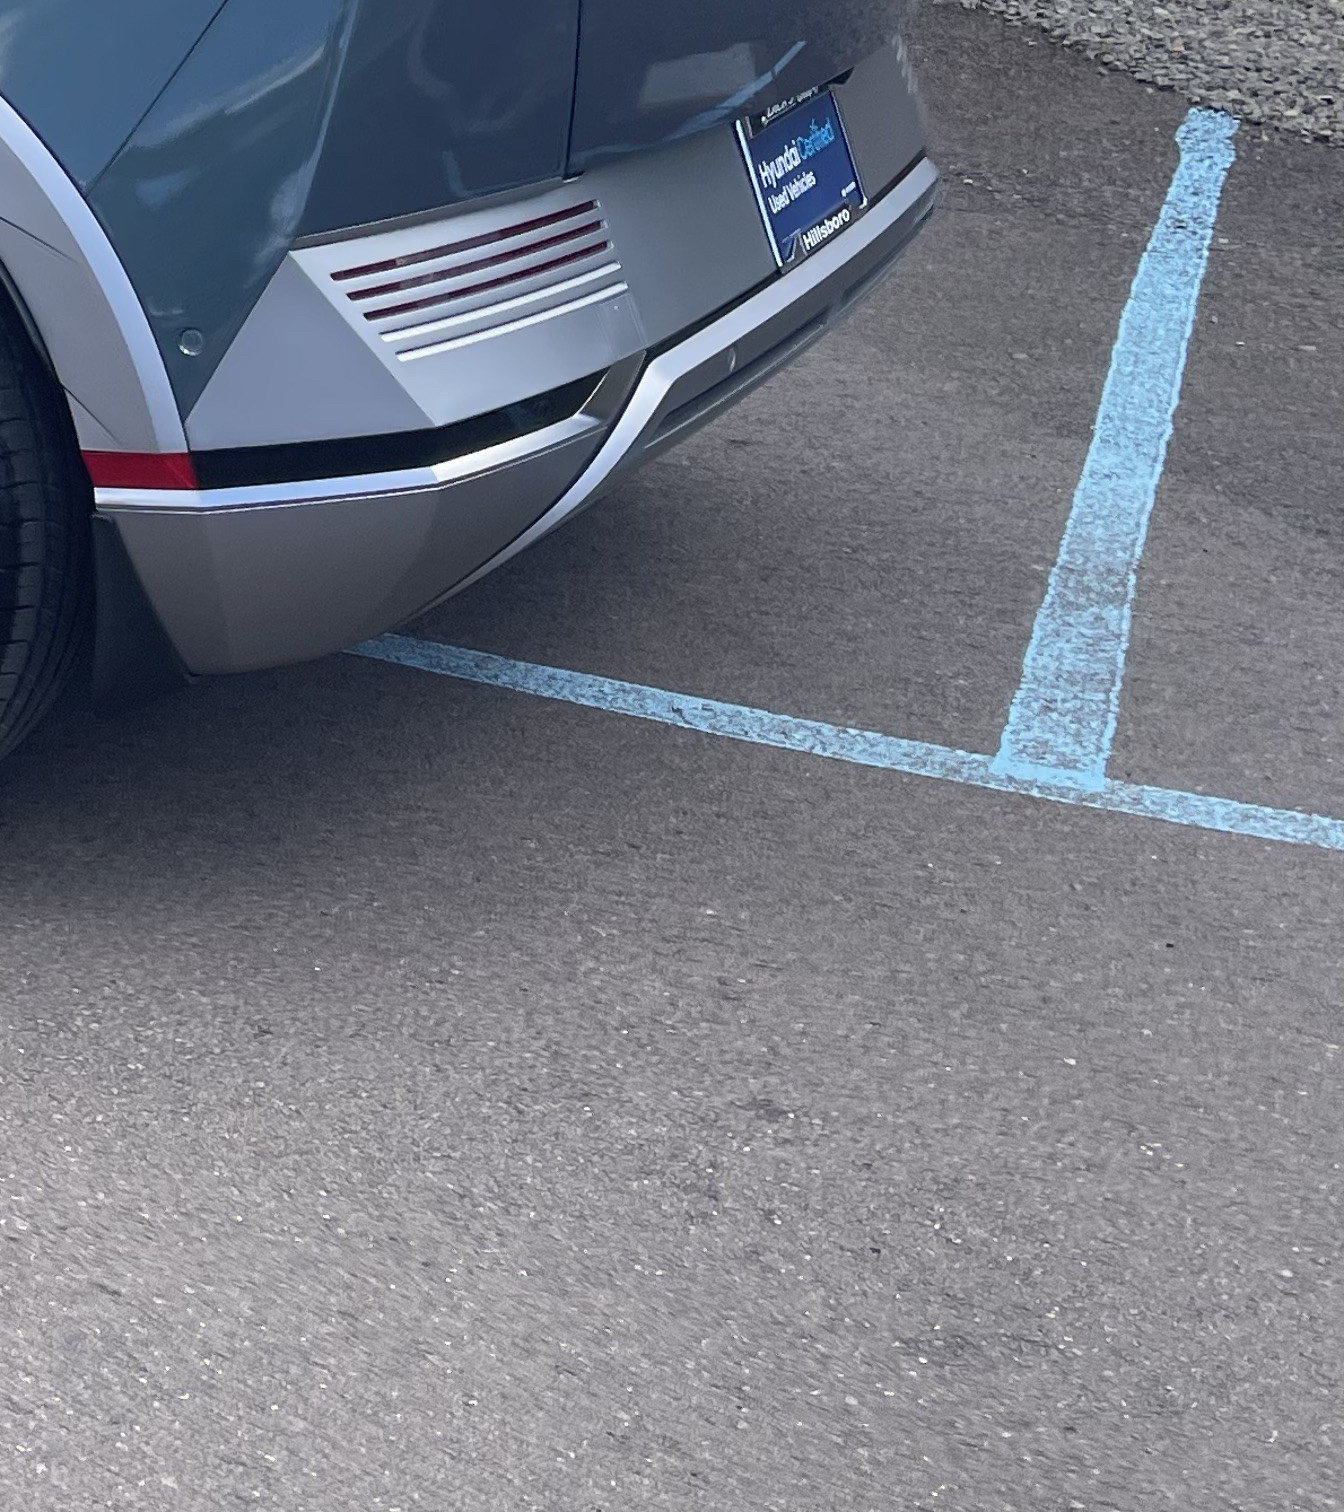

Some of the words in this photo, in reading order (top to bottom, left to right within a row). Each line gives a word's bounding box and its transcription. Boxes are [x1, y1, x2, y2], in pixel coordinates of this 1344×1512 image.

[767, 185, 791, 214] Used
[785, 171, 817, 201] Vehicles
[802, 208, 851, 251] Hillsboro
